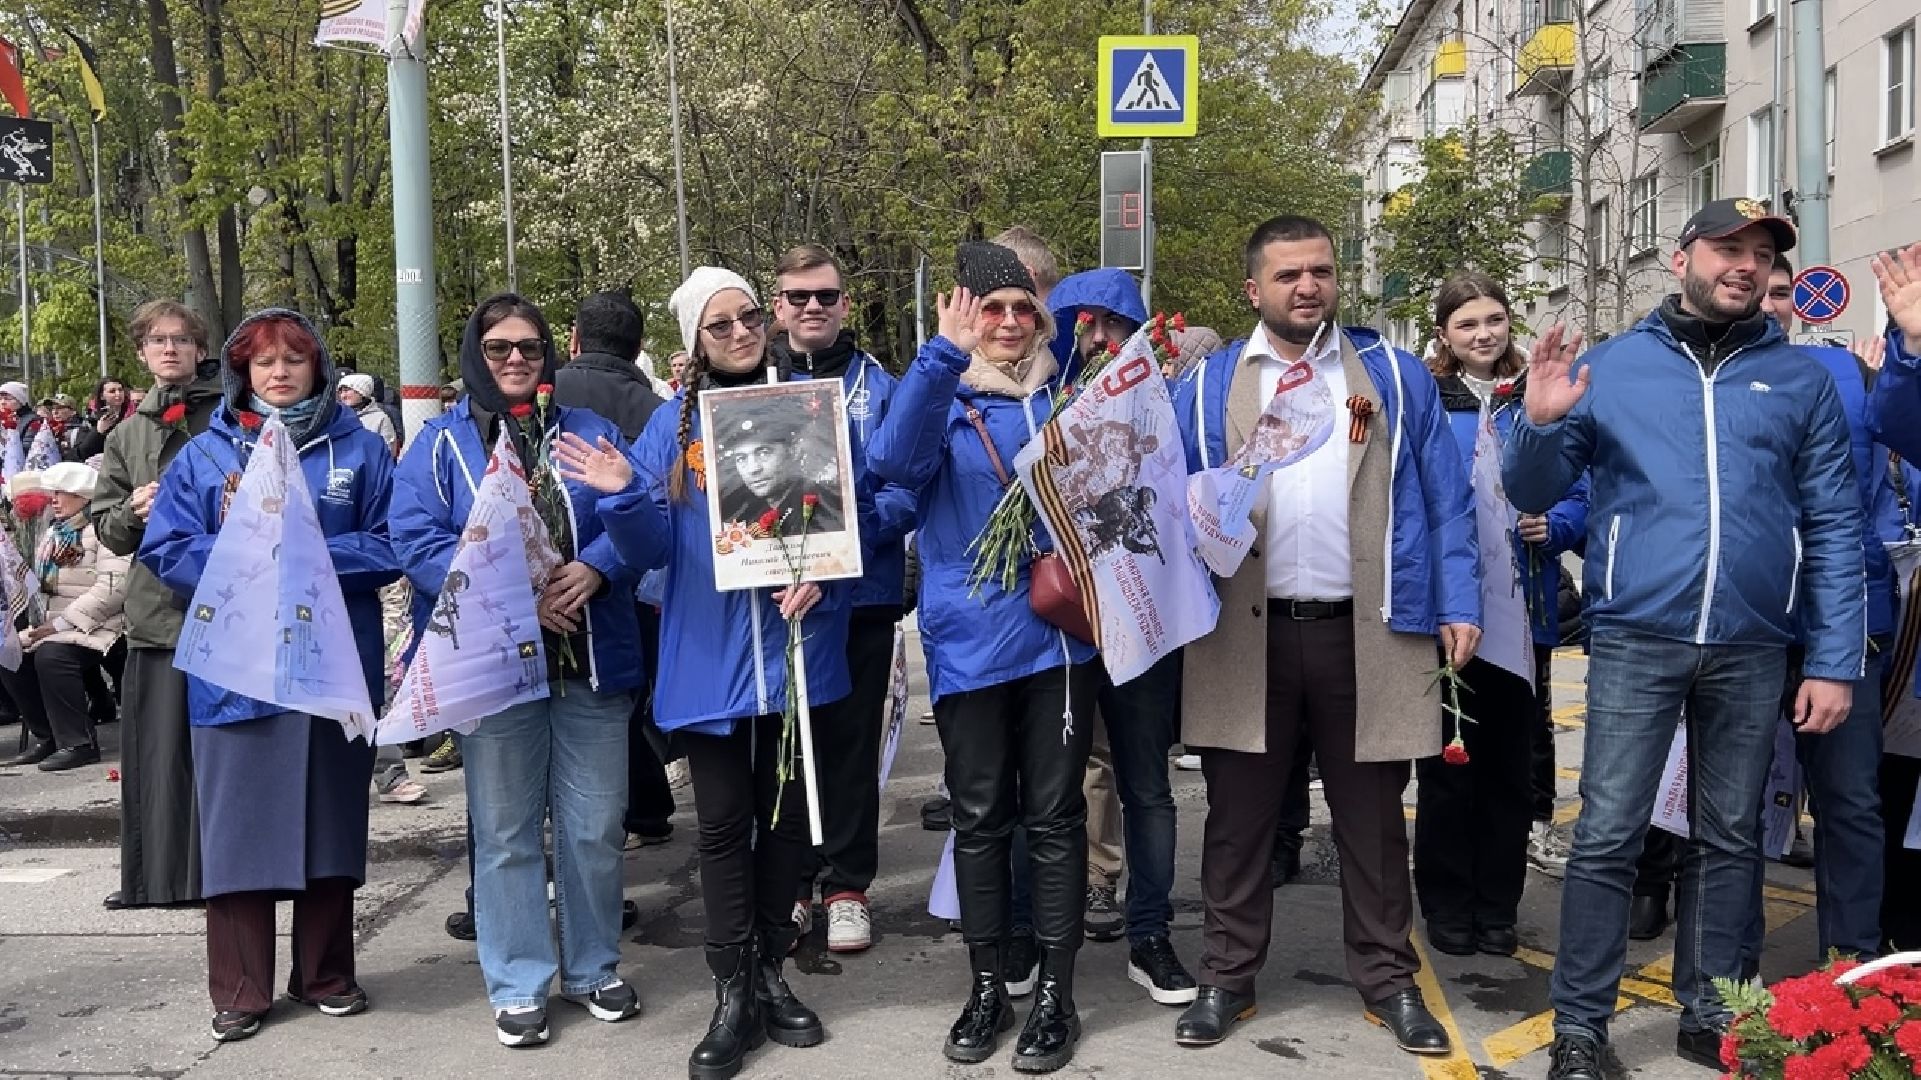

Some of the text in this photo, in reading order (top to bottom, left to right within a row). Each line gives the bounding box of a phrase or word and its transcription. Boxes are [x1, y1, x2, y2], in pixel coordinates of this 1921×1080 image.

[1102, 356, 1151, 397] 9
[1110, 559, 1142, 613] ЗАЩИЩАЕМ
[1122, 553, 1150, 599] СОХРАНЯЯ
